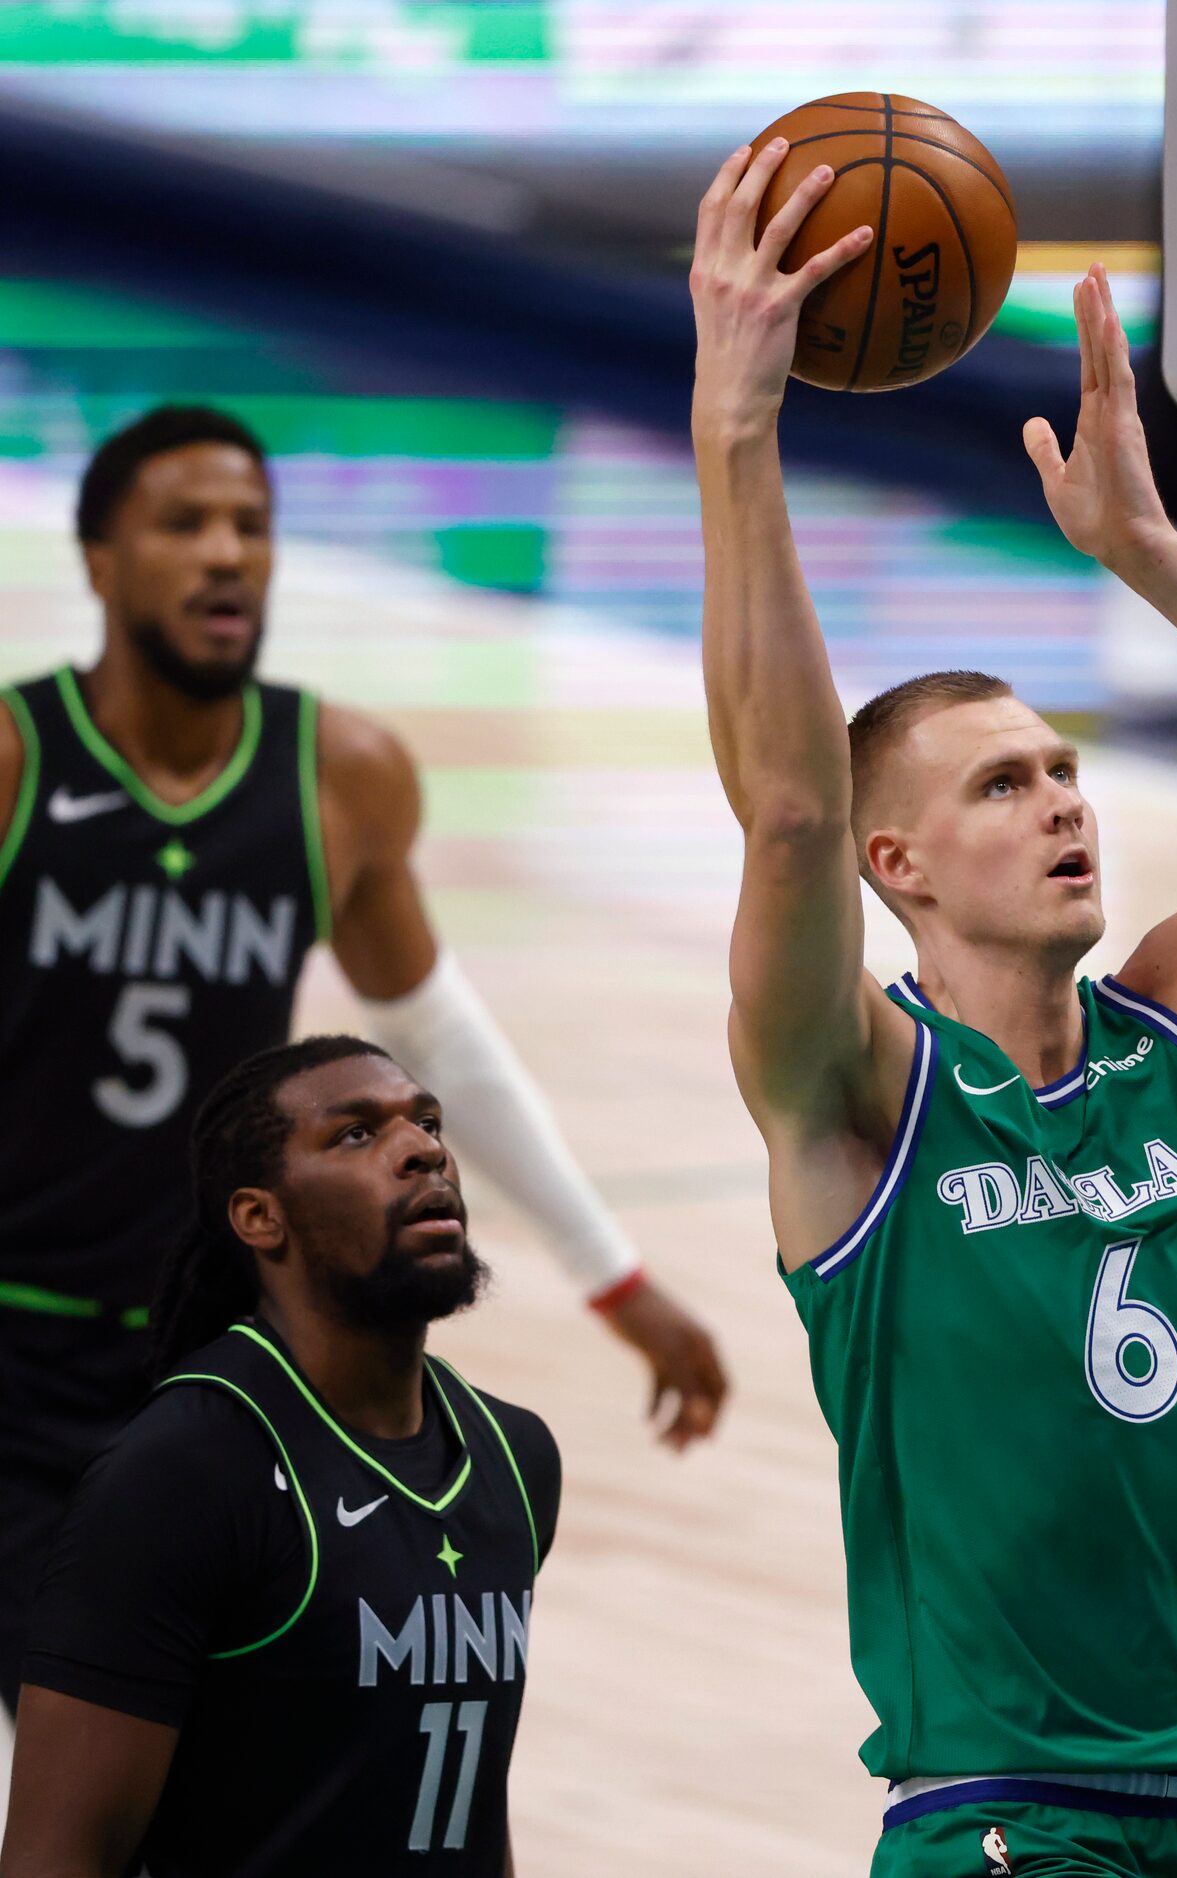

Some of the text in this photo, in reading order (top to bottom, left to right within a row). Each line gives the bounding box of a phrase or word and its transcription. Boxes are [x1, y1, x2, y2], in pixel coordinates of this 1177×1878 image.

[887, 242, 939, 378] SPALDI
[30, 876, 297, 986] MINN
[92, 981, 191, 1127] 5
[1086, 1036, 1154, 1090] chime
[358, 1589, 532, 1687] MINN
[408, 1701, 489, 1853] 11
[990, 1866, 1007, 1876] NBA
